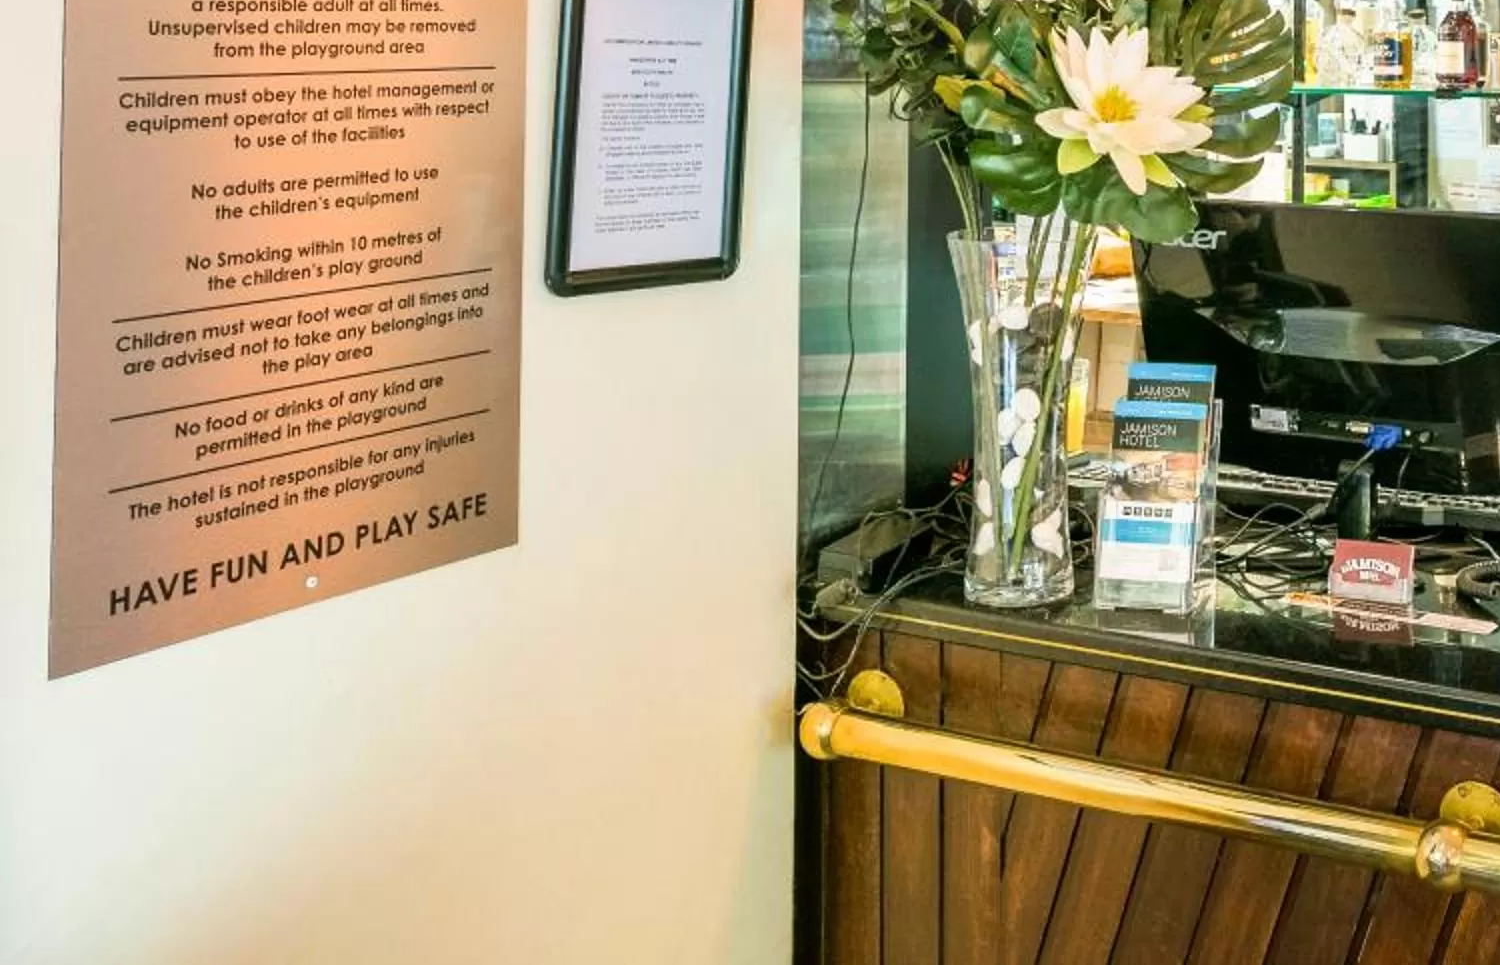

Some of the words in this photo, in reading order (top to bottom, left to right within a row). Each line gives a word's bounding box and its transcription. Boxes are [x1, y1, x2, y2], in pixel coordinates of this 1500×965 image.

[191, 0, 205, 12] a
[148, 18, 269, 37] Unsupervised
[273, 19, 341, 33] children
[346, 22, 382, 36] may
[386, 19, 406, 33] be
[410, 19, 476, 33] removed
[214, 42, 254, 57] from
[259, 41, 287, 56] the
[291, 40, 385, 59] playground
[389, 43, 424, 54] area
[119, 91, 200, 107] Children
[203, 89, 248, 104] must
[251, 87, 296, 104] obey
[301, 86, 328, 100] the
[332, 85, 372, 99] hotel
[376, 81, 479, 99] management
[480, 82, 494, 94] or
[125, 113, 229, 133] equipment
[233, 109, 308, 129] operator
[312, 107, 329, 122] at
[333, 106, 352, 121] all
[355, 105, 398, 119] times
[402, 102, 433, 117] with
[435, 99, 489, 117] respect
[234, 134, 252, 148] to
[256, 134, 288, 147] use
[291, 129, 308, 145] of
[312, 129, 338, 144] the
[341, 125, 406, 142] facilities
[192, 183, 218, 199] No
[222, 179, 275, 196] adults
[280, 179, 308, 191] are
[312, 169, 390, 193] permitted
[394, 167, 409, 182] to
[412, 168, 438, 181] use
[215, 201, 244, 218] the
[248, 196, 330, 215] children's
[334, 188, 419, 210] equipment
[186, 255, 213, 269] No
[217, 247, 293, 267] Smoking
[297, 239, 344, 257] within
[350, 235, 368, 251] 10
[371, 232, 425, 249] metres
[427, 227, 442, 243] of
[1162, 229, 1228, 249] cer
[208, 272, 238, 289] the
[240, 263, 324, 285] children's
[328, 259, 366, 279] play
[367, 251, 422, 273] ground
[116, 330, 197, 351] Children
[202, 321, 245, 339] must
[250, 315, 293, 331] wear
[297, 308, 329, 325] foot
[334, 303, 374, 320] wear
[377, 296, 393, 313] at
[396, 293, 415, 310] all
[419, 291, 458, 306] times
[460, 283, 489, 300] and
[124, 358, 156, 373] are
[161, 343, 235, 369] advised
[239, 337, 269, 356] not
[272, 335, 289, 350] to
[294, 330, 333, 347] take
[335, 325, 367, 343] any
[371, 311, 455, 336] belongings
[457, 305, 483, 321] into
[262, 359, 290, 374] the
[294, 352, 332, 373] play
[335, 346, 373, 362] area
[175, 421, 202, 437] No
[205, 412, 248, 431] food
[253, 409, 269, 422] or
[275, 398, 324, 419] drinks
[329, 391, 344, 408] of
[346, 387, 382, 405] any
[382, 378, 415, 398] kind
[418, 376, 444, 390] are
[1135, 384, 1191, 399] JAMISON
[196, 427, 282, 458] permitted
[284, 423, 302, 437] in
[305, 415, 334, 433] the
[337, 397, 427, 431] playground
[1120, 422, 1177, 437] JAMISON
[1120, 435, 1161, 448] HOTEL
[128, 502, 162, 518] The
[167, 486, 215, 511] hotel
[219, 483, 234, 499] is
[237, 476, 266, 495] not
[269, 455, 364, 488] responsible
[368, 448, 388, 466] for
[393, 443, 422, 462] any
[425, 431, 475, 454] injuries
[195, 497, 280, 527] sustained
[284, 490, 298, 506] in
[303, 483, 331, 501] the
[333, 461, 424, 497] playground
[110, 569, 198, 615] HAVE
[211, 551, 268, 588] FUN
[280, 532, 344, 569] AND
[356, 512, 418, 549] PLAY
[428, 494, 486, 529] SAFE
